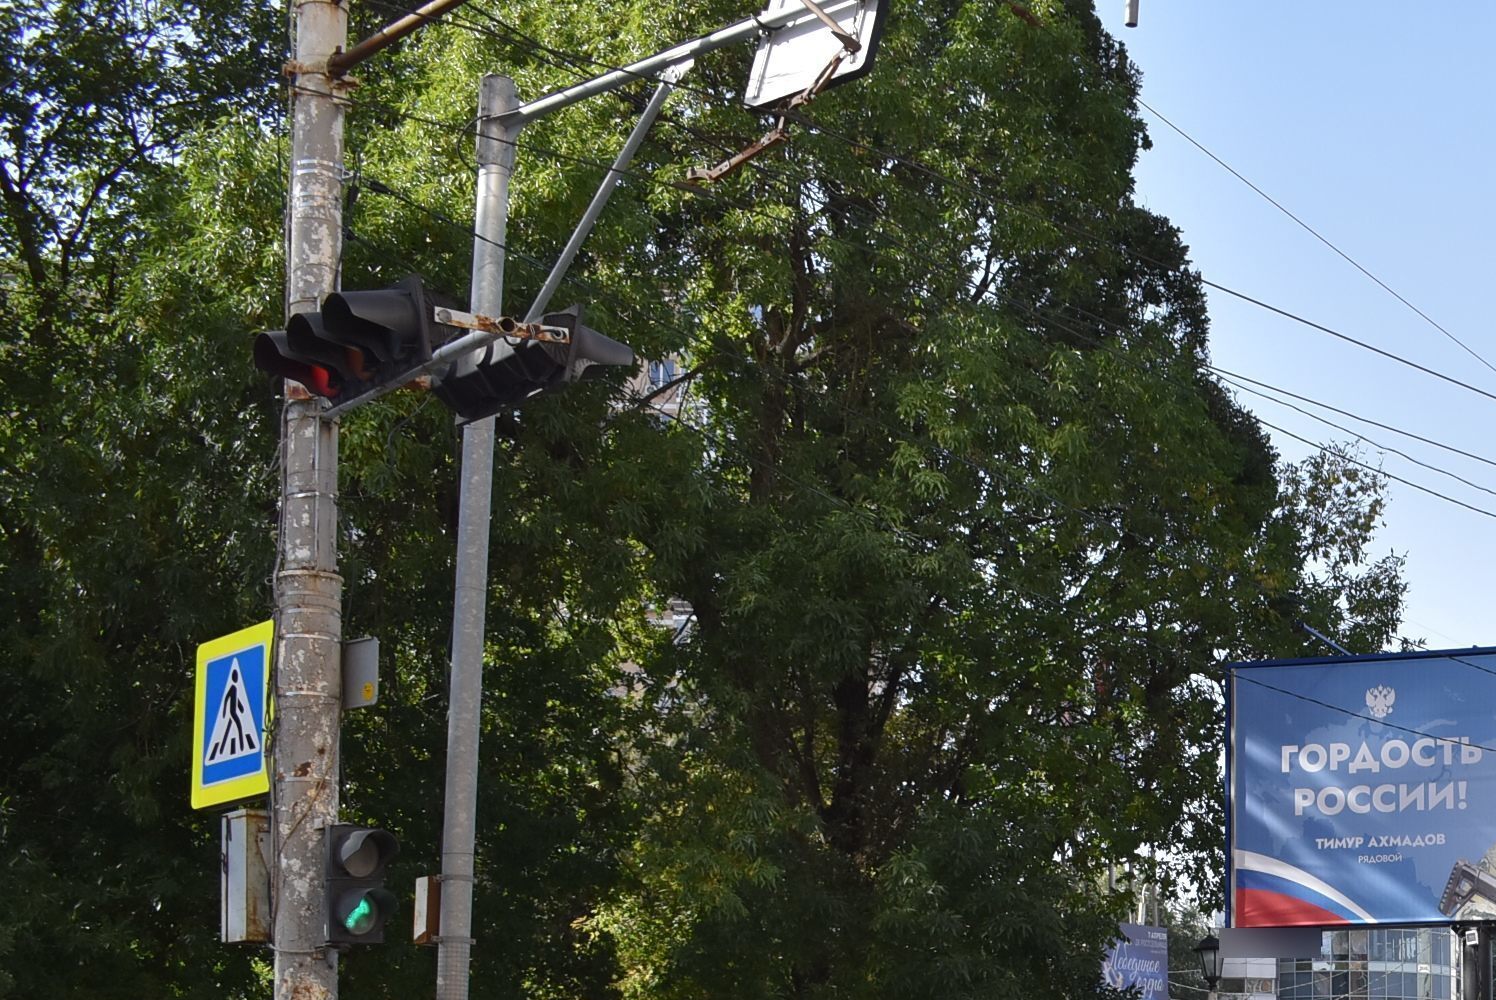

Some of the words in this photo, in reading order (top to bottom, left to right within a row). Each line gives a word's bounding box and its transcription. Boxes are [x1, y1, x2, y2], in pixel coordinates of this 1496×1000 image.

[1281, 736, 1483, 774] ГОРДОСТЬ
[1294, 781, 1467, 816] РОССИИ!
[1315, 836, 1364, 850] ТИМУР
[1368, 833, 1446, 848] АХМАДОВ
[1358, 852, 1403, 864] РЯДОВОЙ
